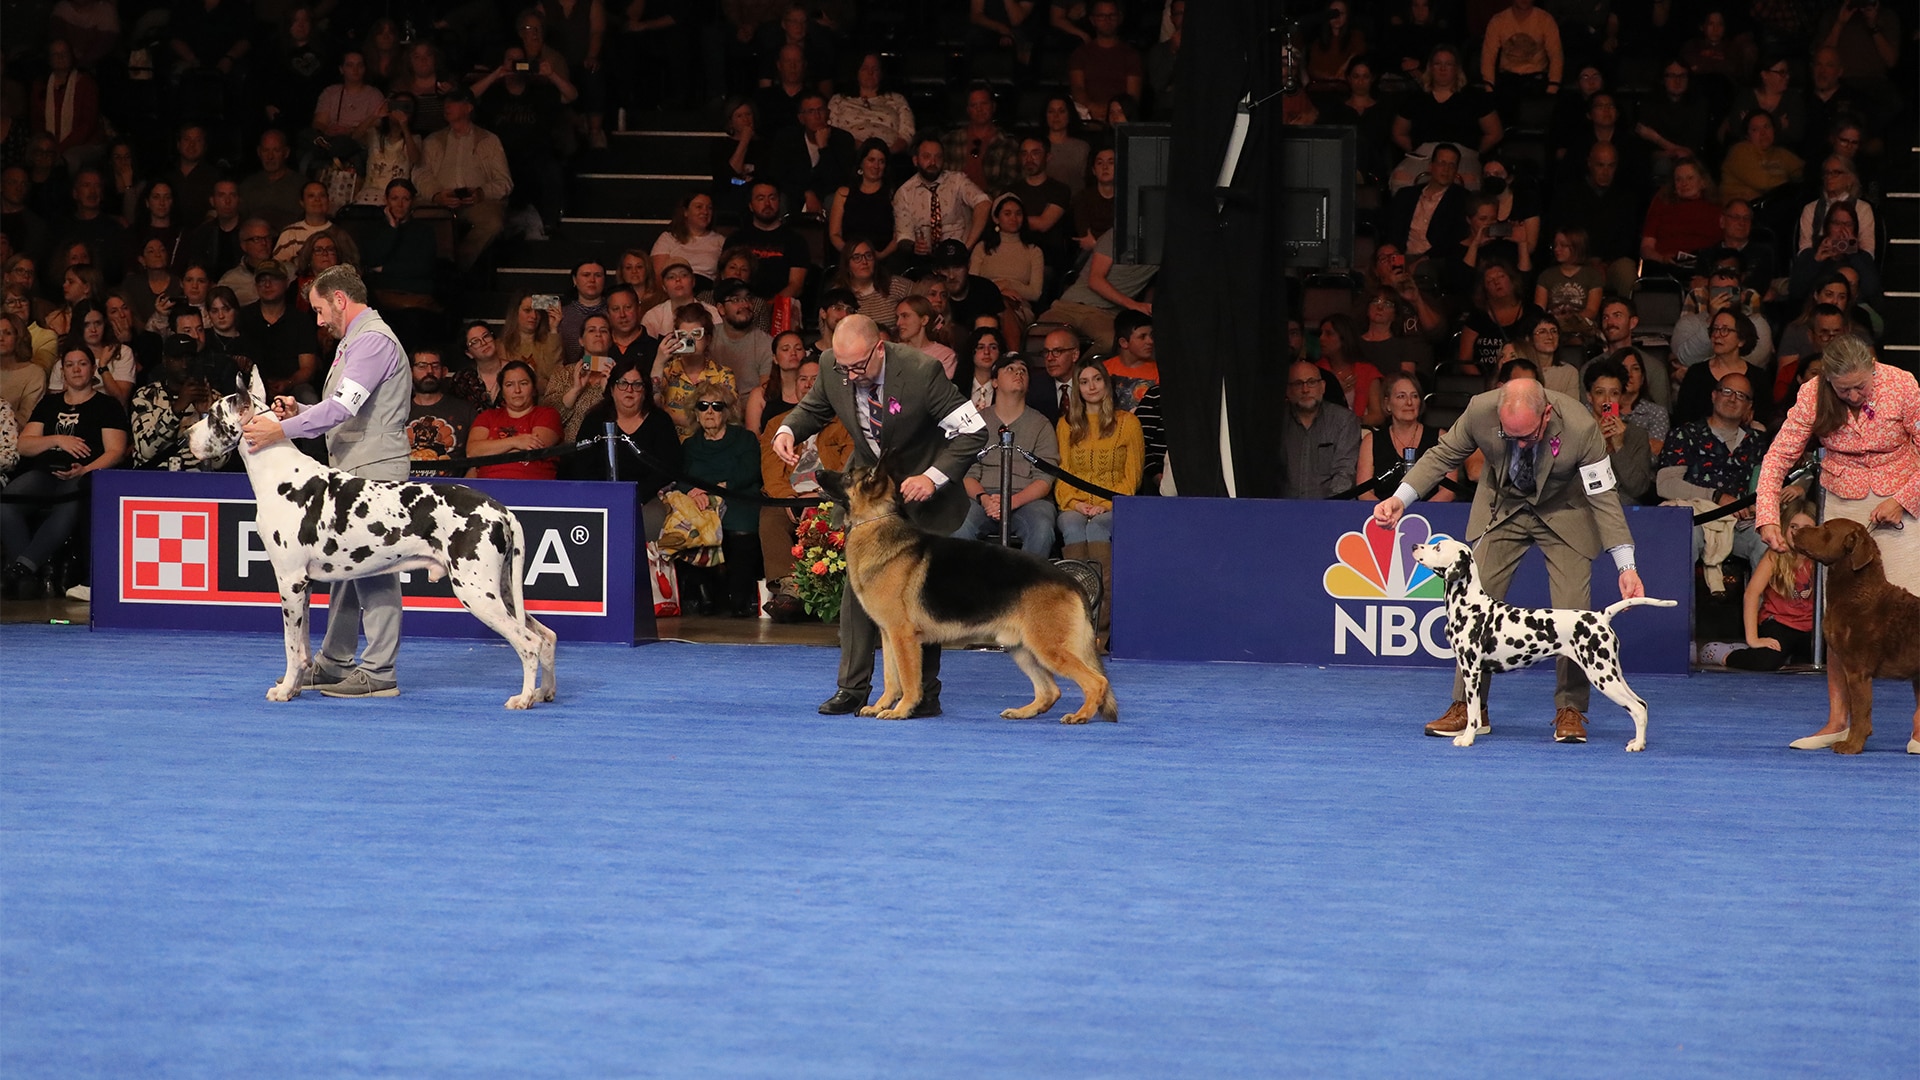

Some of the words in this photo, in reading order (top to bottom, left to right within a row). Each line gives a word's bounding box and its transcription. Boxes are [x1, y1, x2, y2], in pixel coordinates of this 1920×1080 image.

[351, 391, 361, 405] 19
[960, 413, 973, 427] 14
[1334, 603, 1457, 660] NBC
